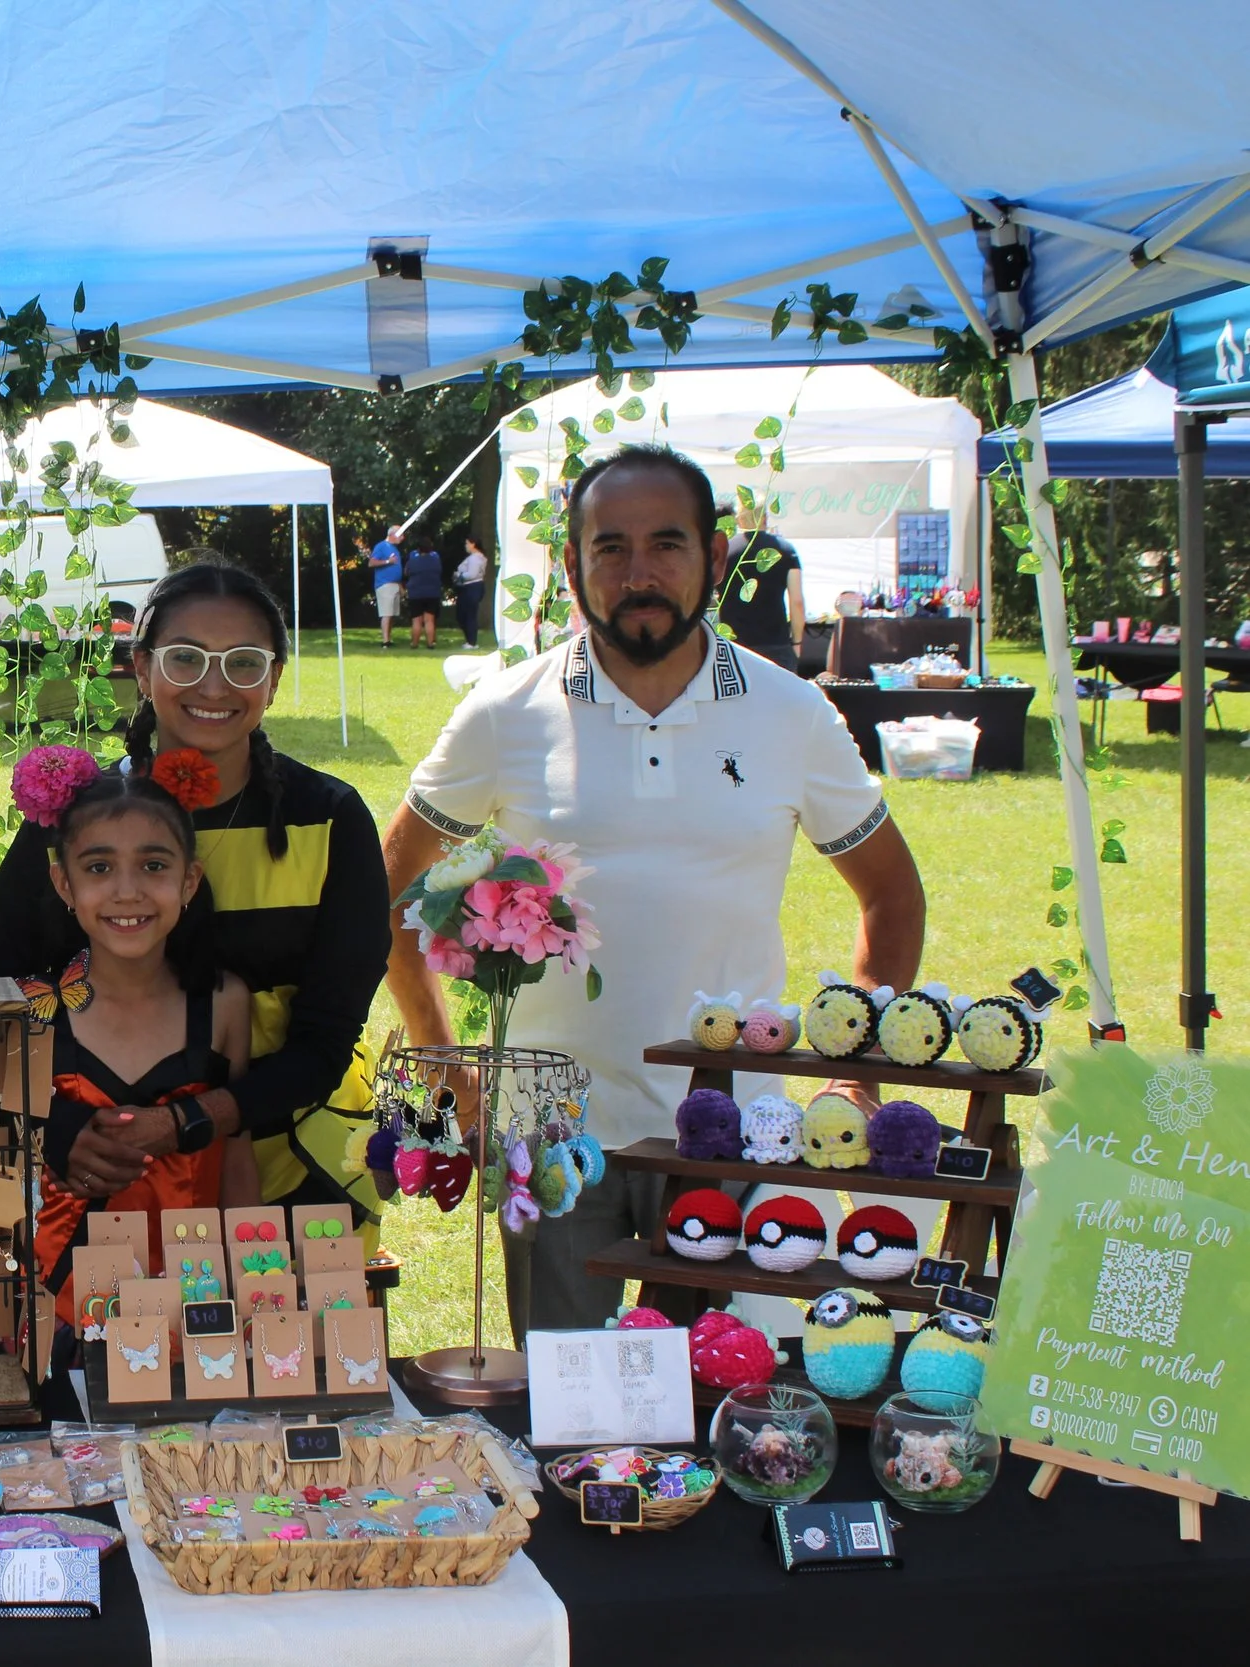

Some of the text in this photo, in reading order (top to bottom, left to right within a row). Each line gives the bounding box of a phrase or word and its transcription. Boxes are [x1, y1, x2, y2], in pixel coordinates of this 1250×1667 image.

[1054, 1122, 1121, 1159] Art
[1130, 1133, 1164, 1166] &
[1128, 1174, 1185, 1200] BY: ERICA
[1075, 1200, 1146, 1231] Follow
[1196, 1216, 1233, 1248] On
[1036, 1326, 1132, 1371] Payment
[1052, 1379, 1219, 1436] 224-538-9347 CASH
[1168, 1435, 1203, 1463] CARD
